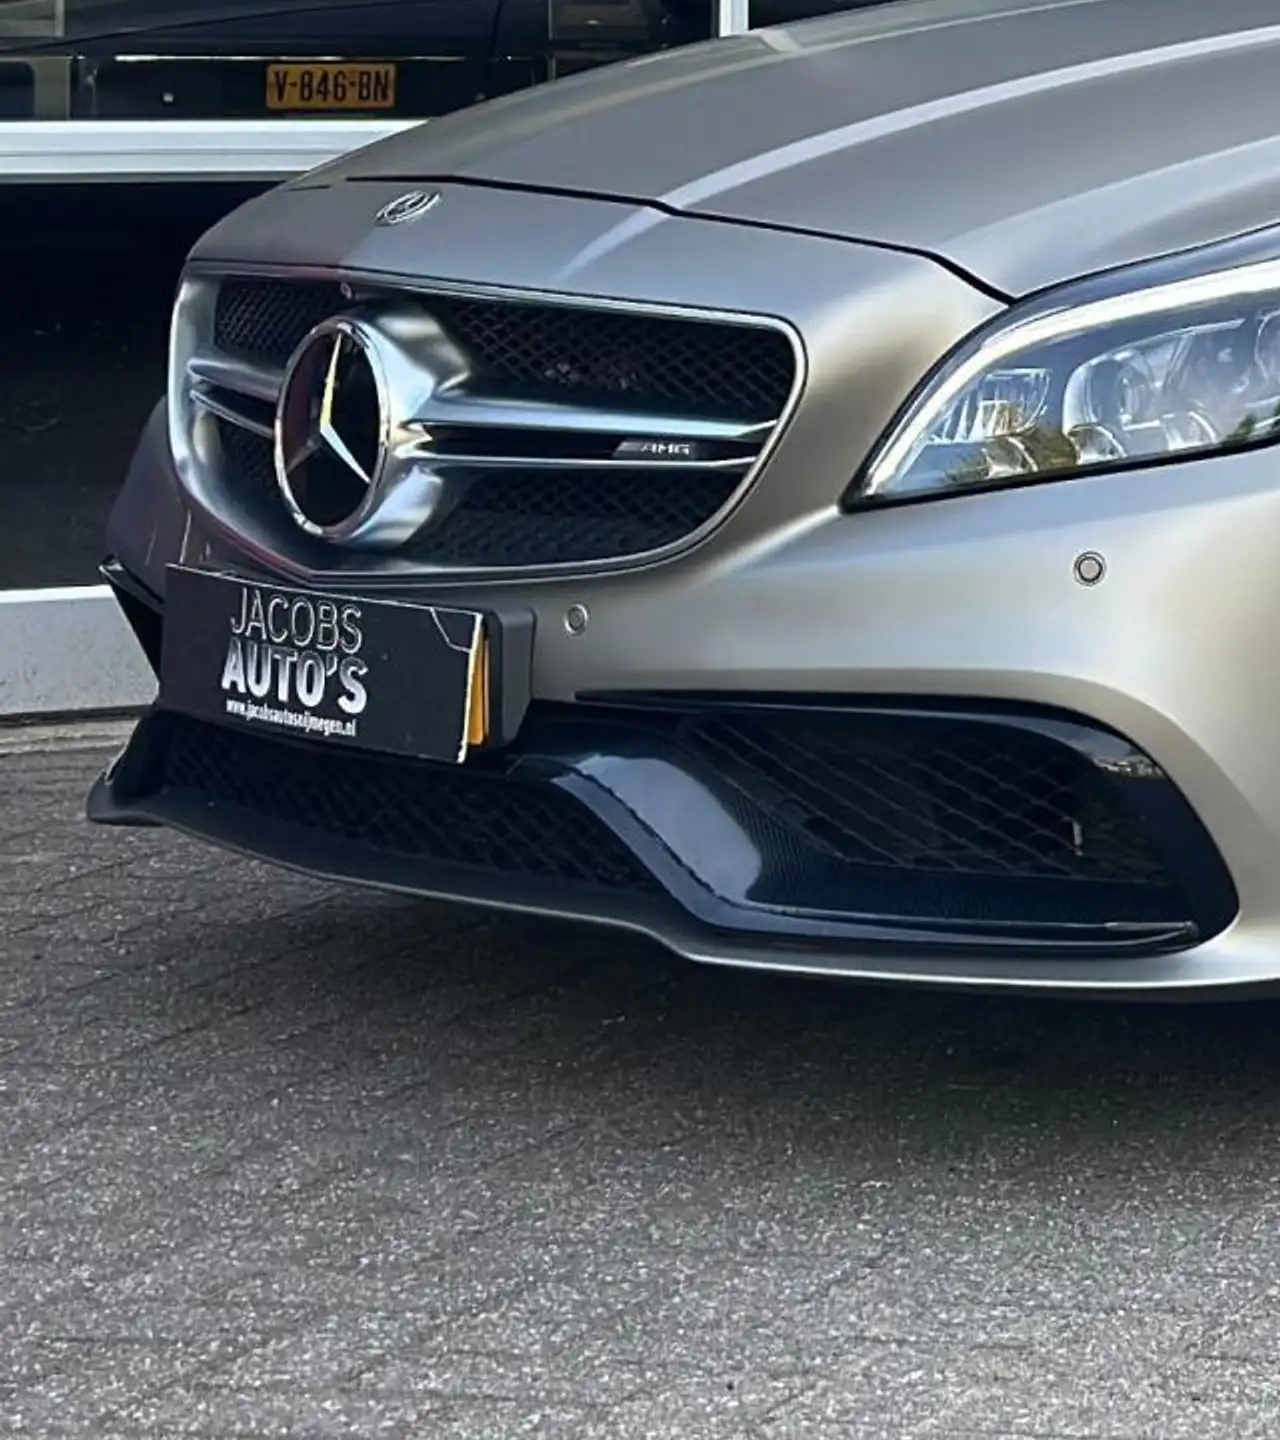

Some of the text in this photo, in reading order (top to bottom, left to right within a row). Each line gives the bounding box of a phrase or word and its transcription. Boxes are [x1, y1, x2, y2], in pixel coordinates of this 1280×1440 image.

[274, 70, 390, 102] V-846-BN
[230, 587, 363, 654] JACOBS
[221, 639, 369, 714] AUTO'S
